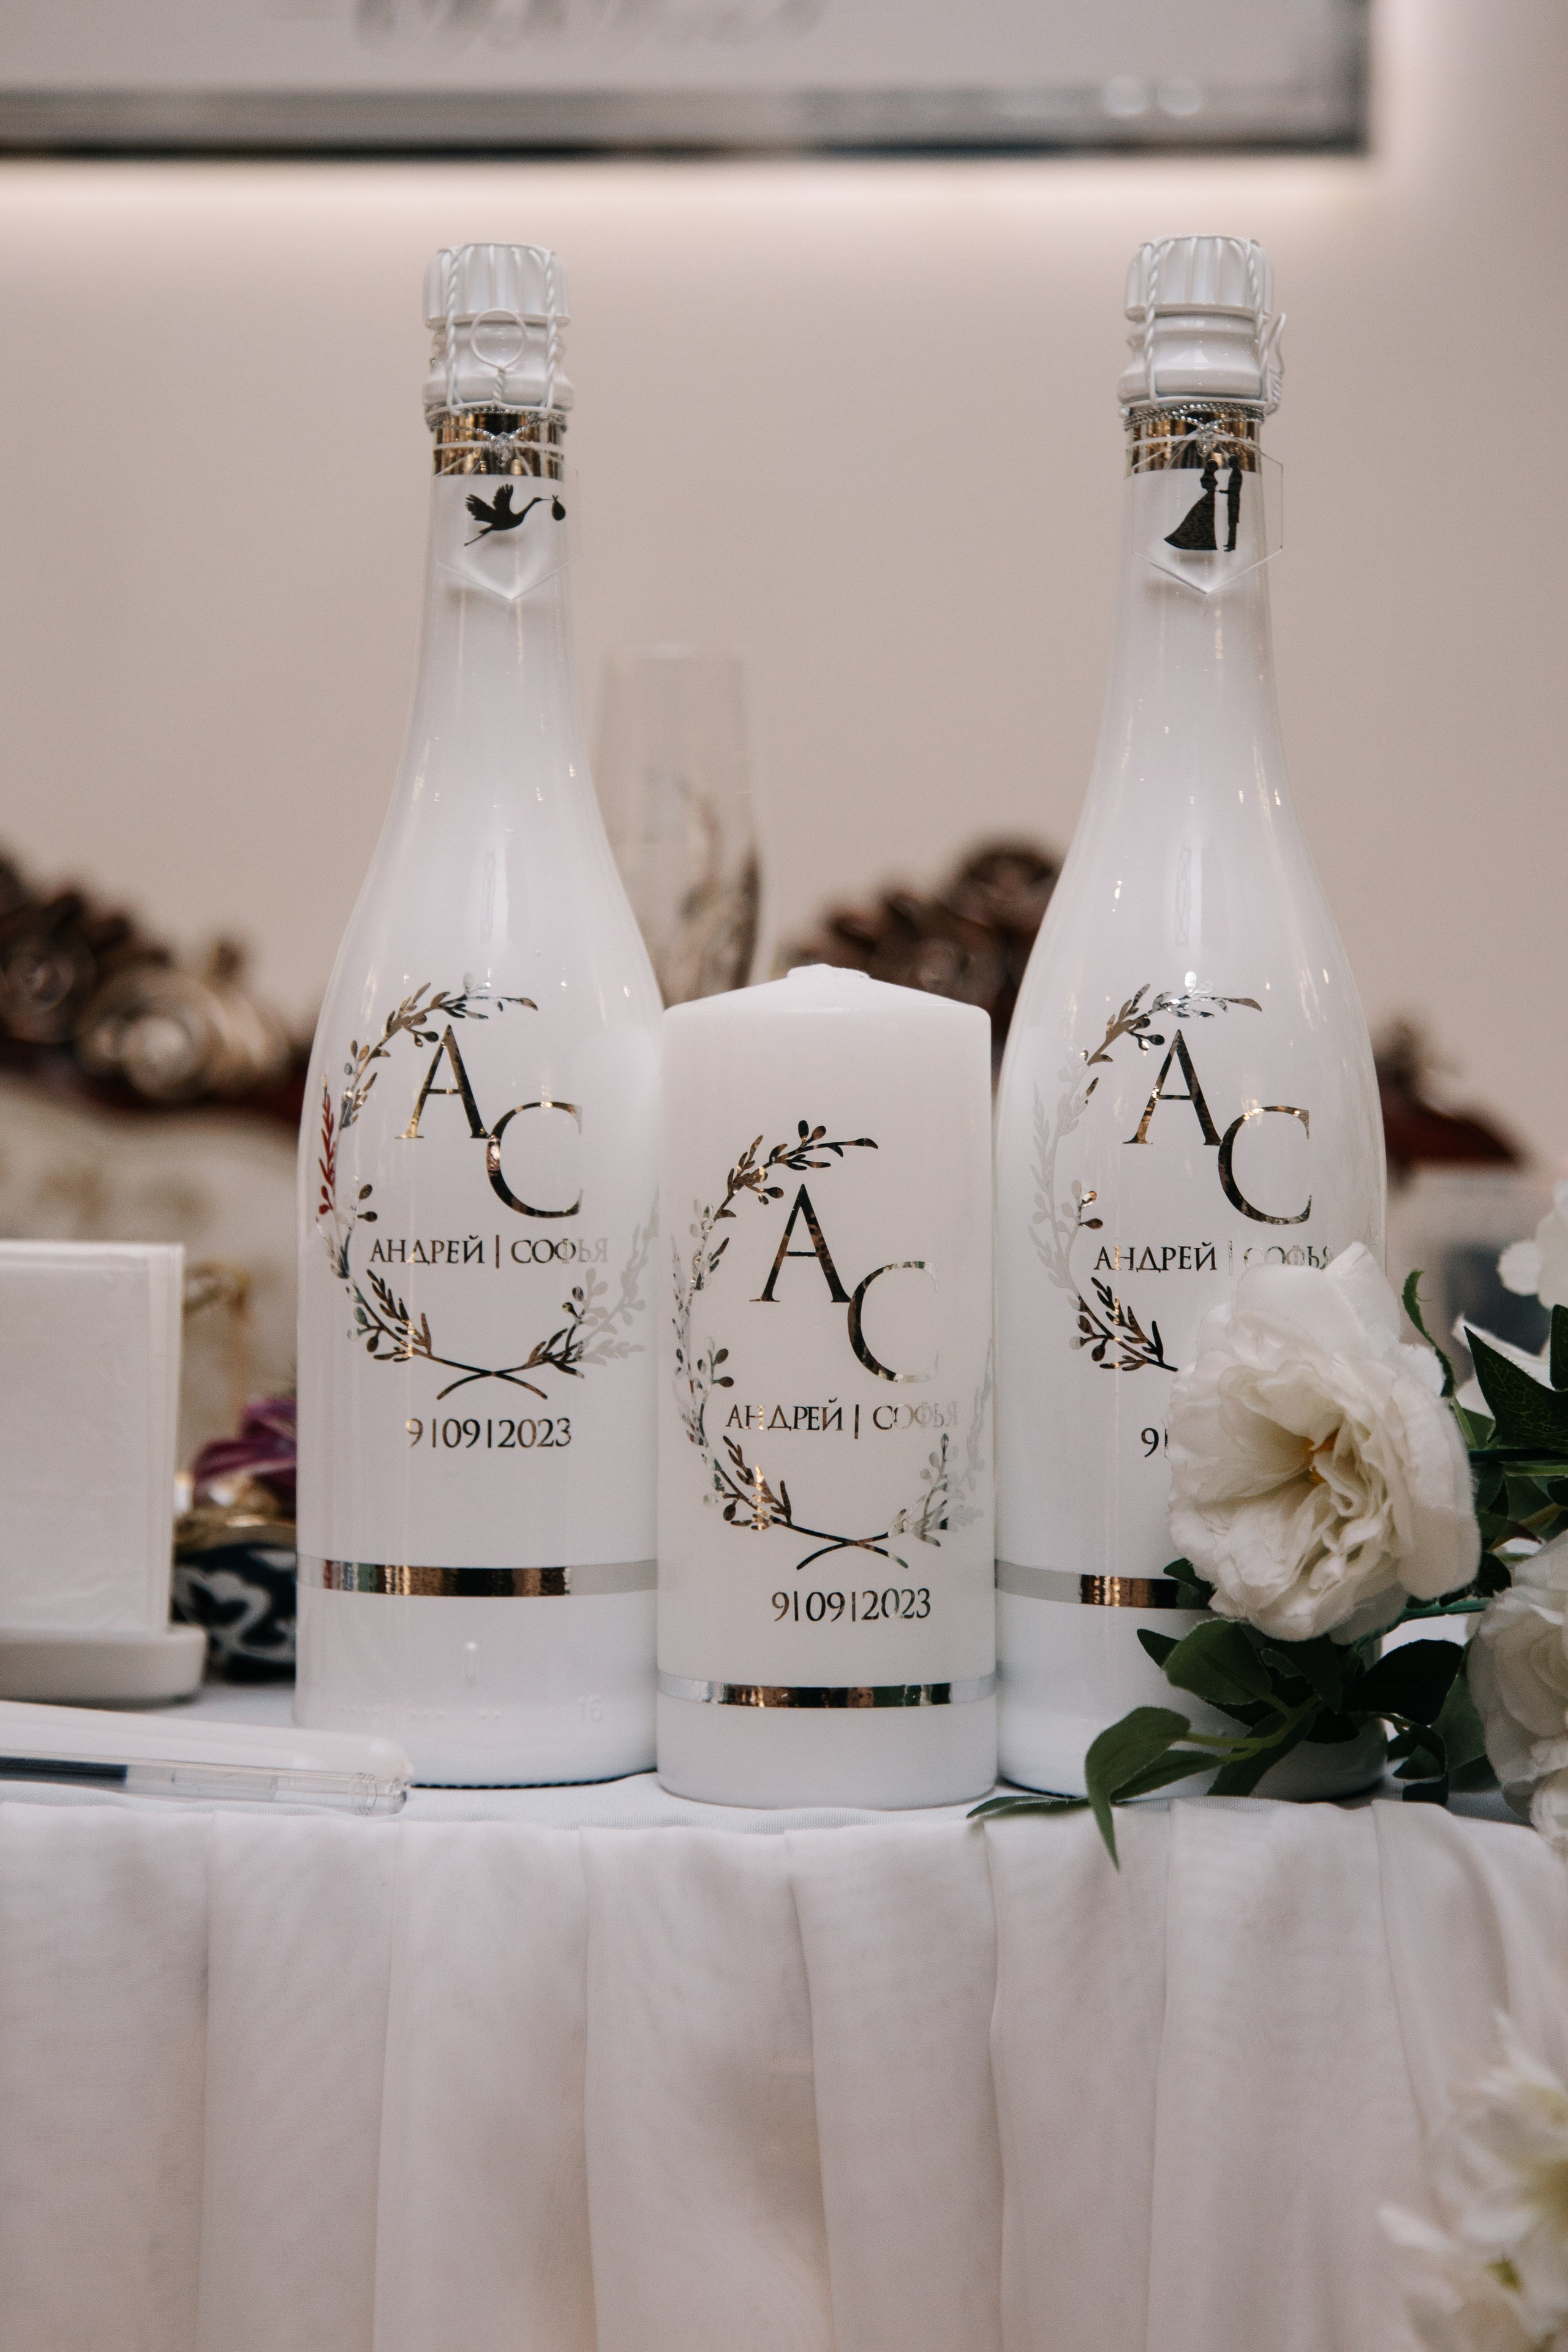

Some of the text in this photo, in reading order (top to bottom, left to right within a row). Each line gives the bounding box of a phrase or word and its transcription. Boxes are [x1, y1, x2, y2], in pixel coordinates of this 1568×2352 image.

[370, 1235, 485, 1265] АНДРЕЙ
[510, 1238, 609, 1264] СОФЬЯ
[1093, 1242, 1218, 1273] АНДРЕЙ
[725, 1397, 845, 1431] АНДРЕЙ
[873, 1401, 959, 1430] СОФЬЯ
